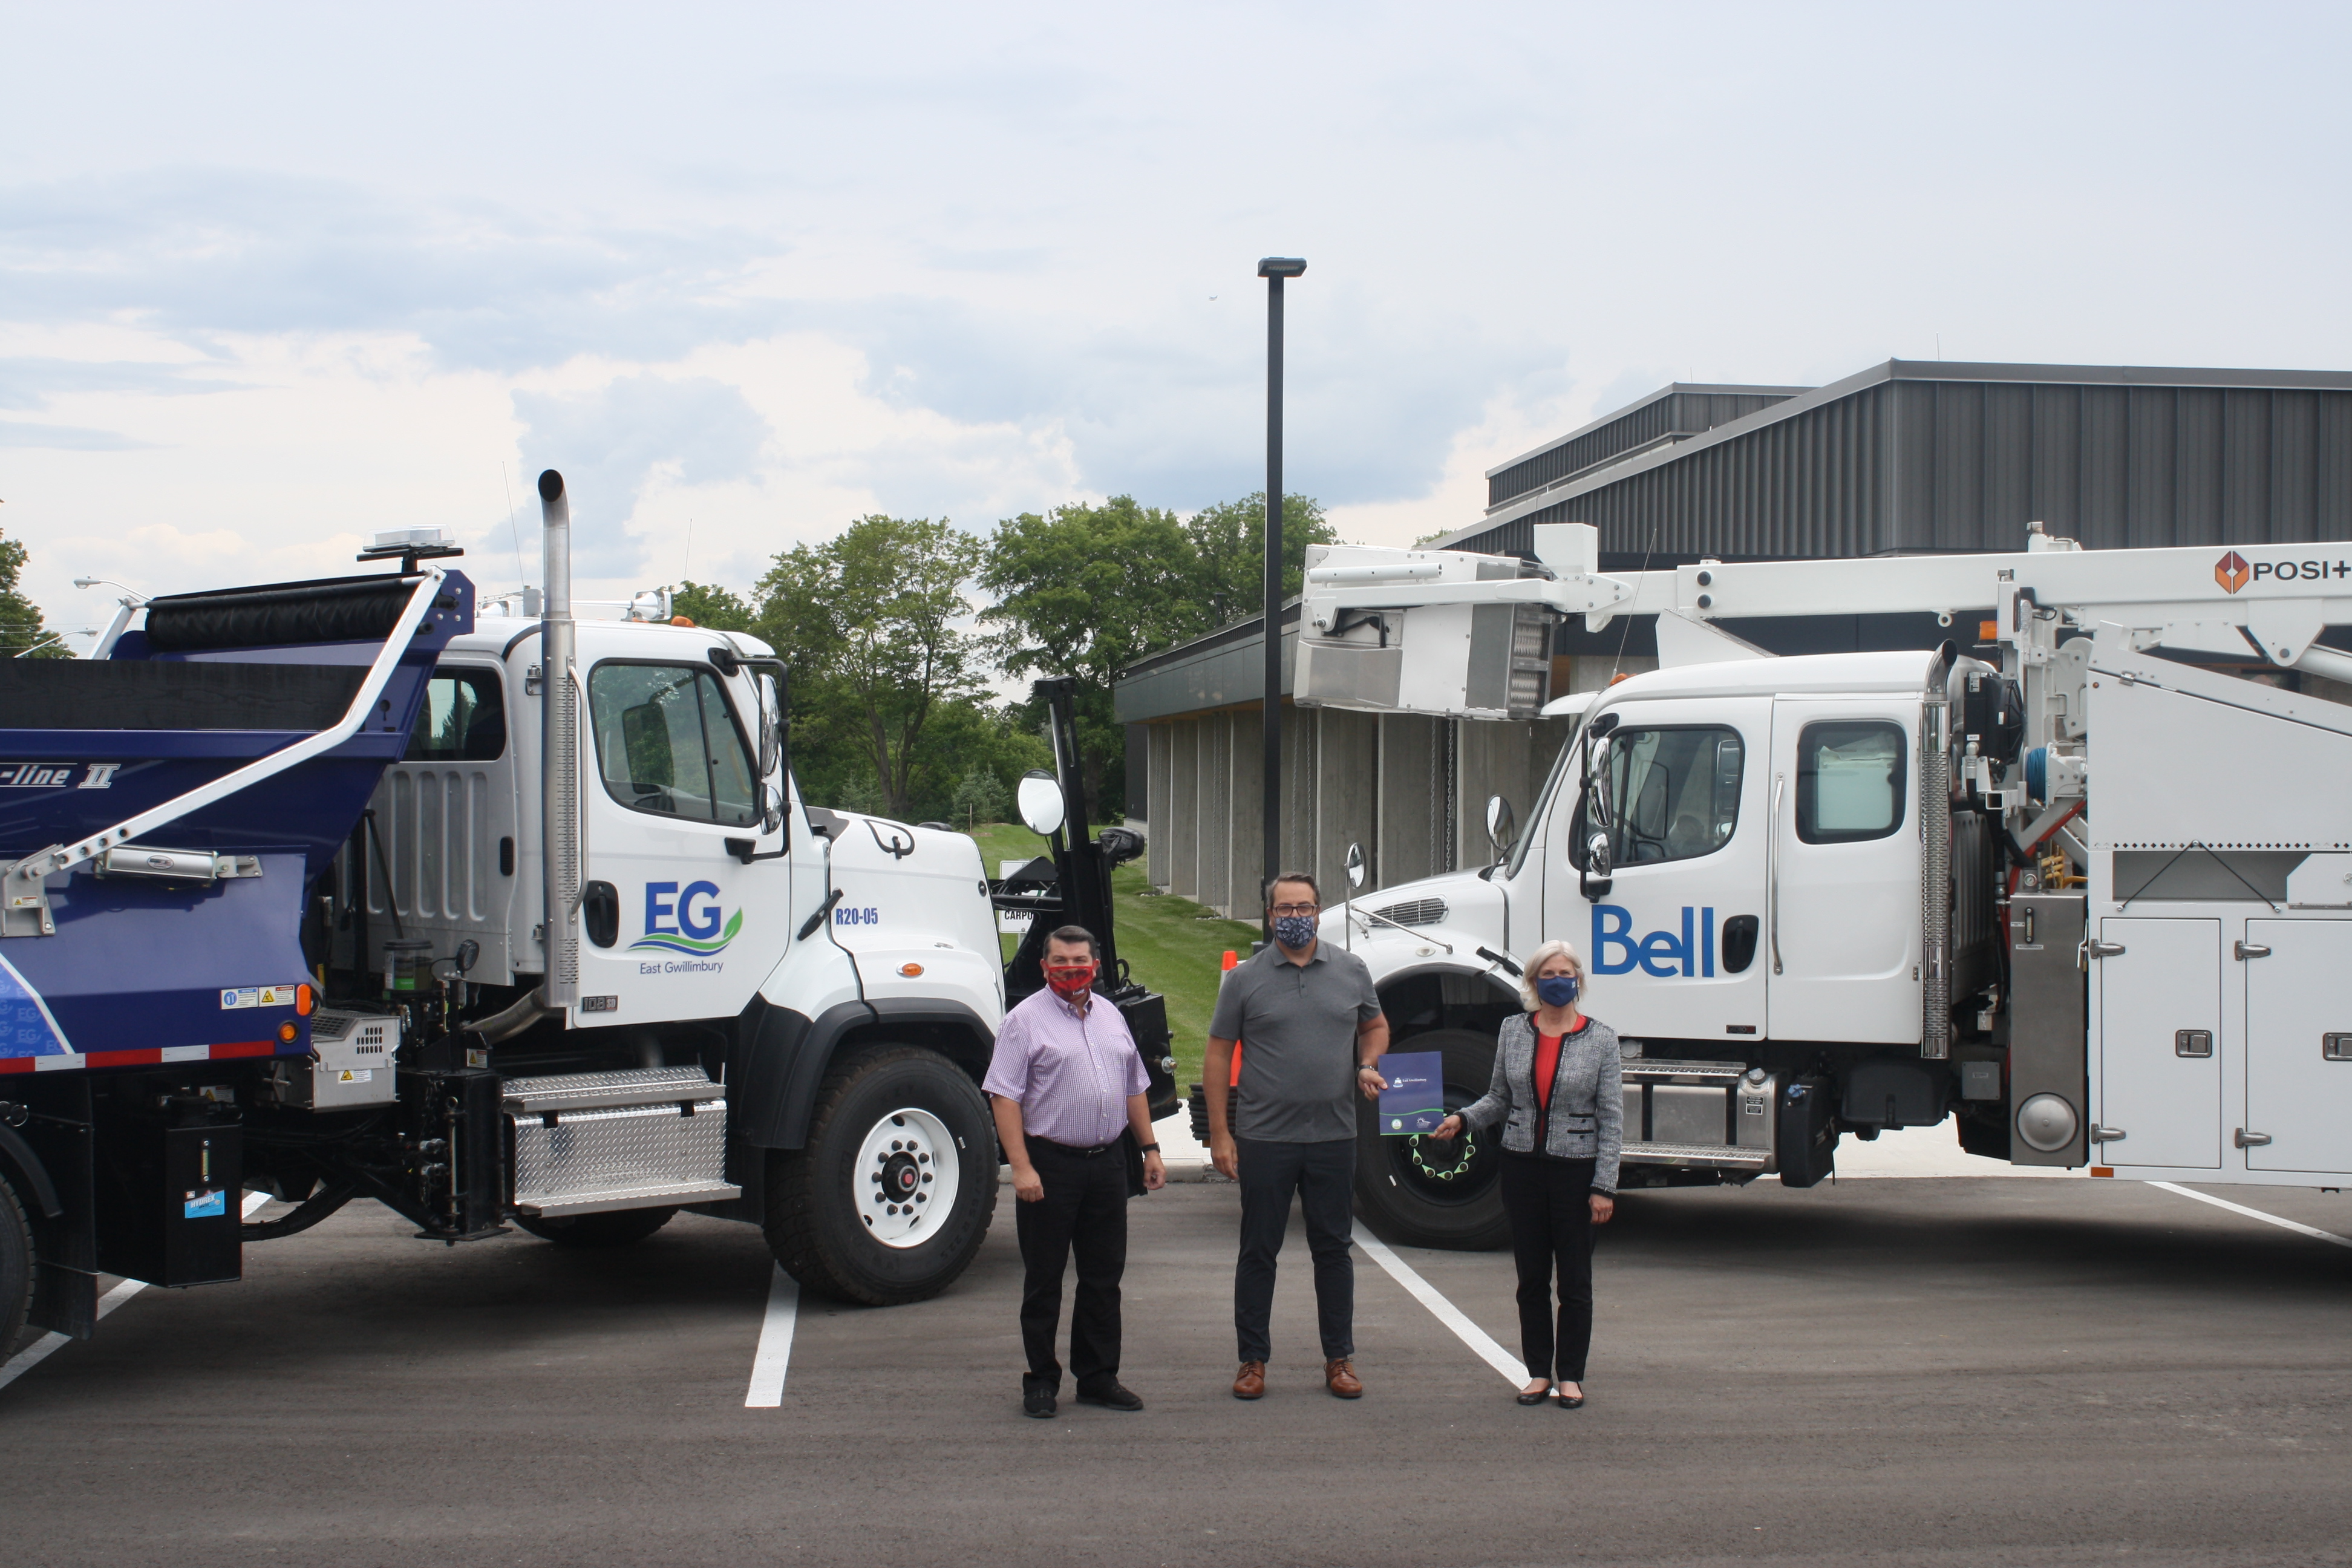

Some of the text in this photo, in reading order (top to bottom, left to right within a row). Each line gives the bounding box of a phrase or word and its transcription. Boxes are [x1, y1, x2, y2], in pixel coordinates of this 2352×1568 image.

[2253, 560, 2351, 581] POSI+
[645, 880, 721, 940] EG
[836, 907, 878, 924] R20-05
[1592, 904, 1714, 978] Bell
[640, 961, 724, 974] East Gwillimbury
[583, 997, 605, 1011] 108
[18, 1007, 36, 1020] EG
[18, 1029, 36, 1041] EG
